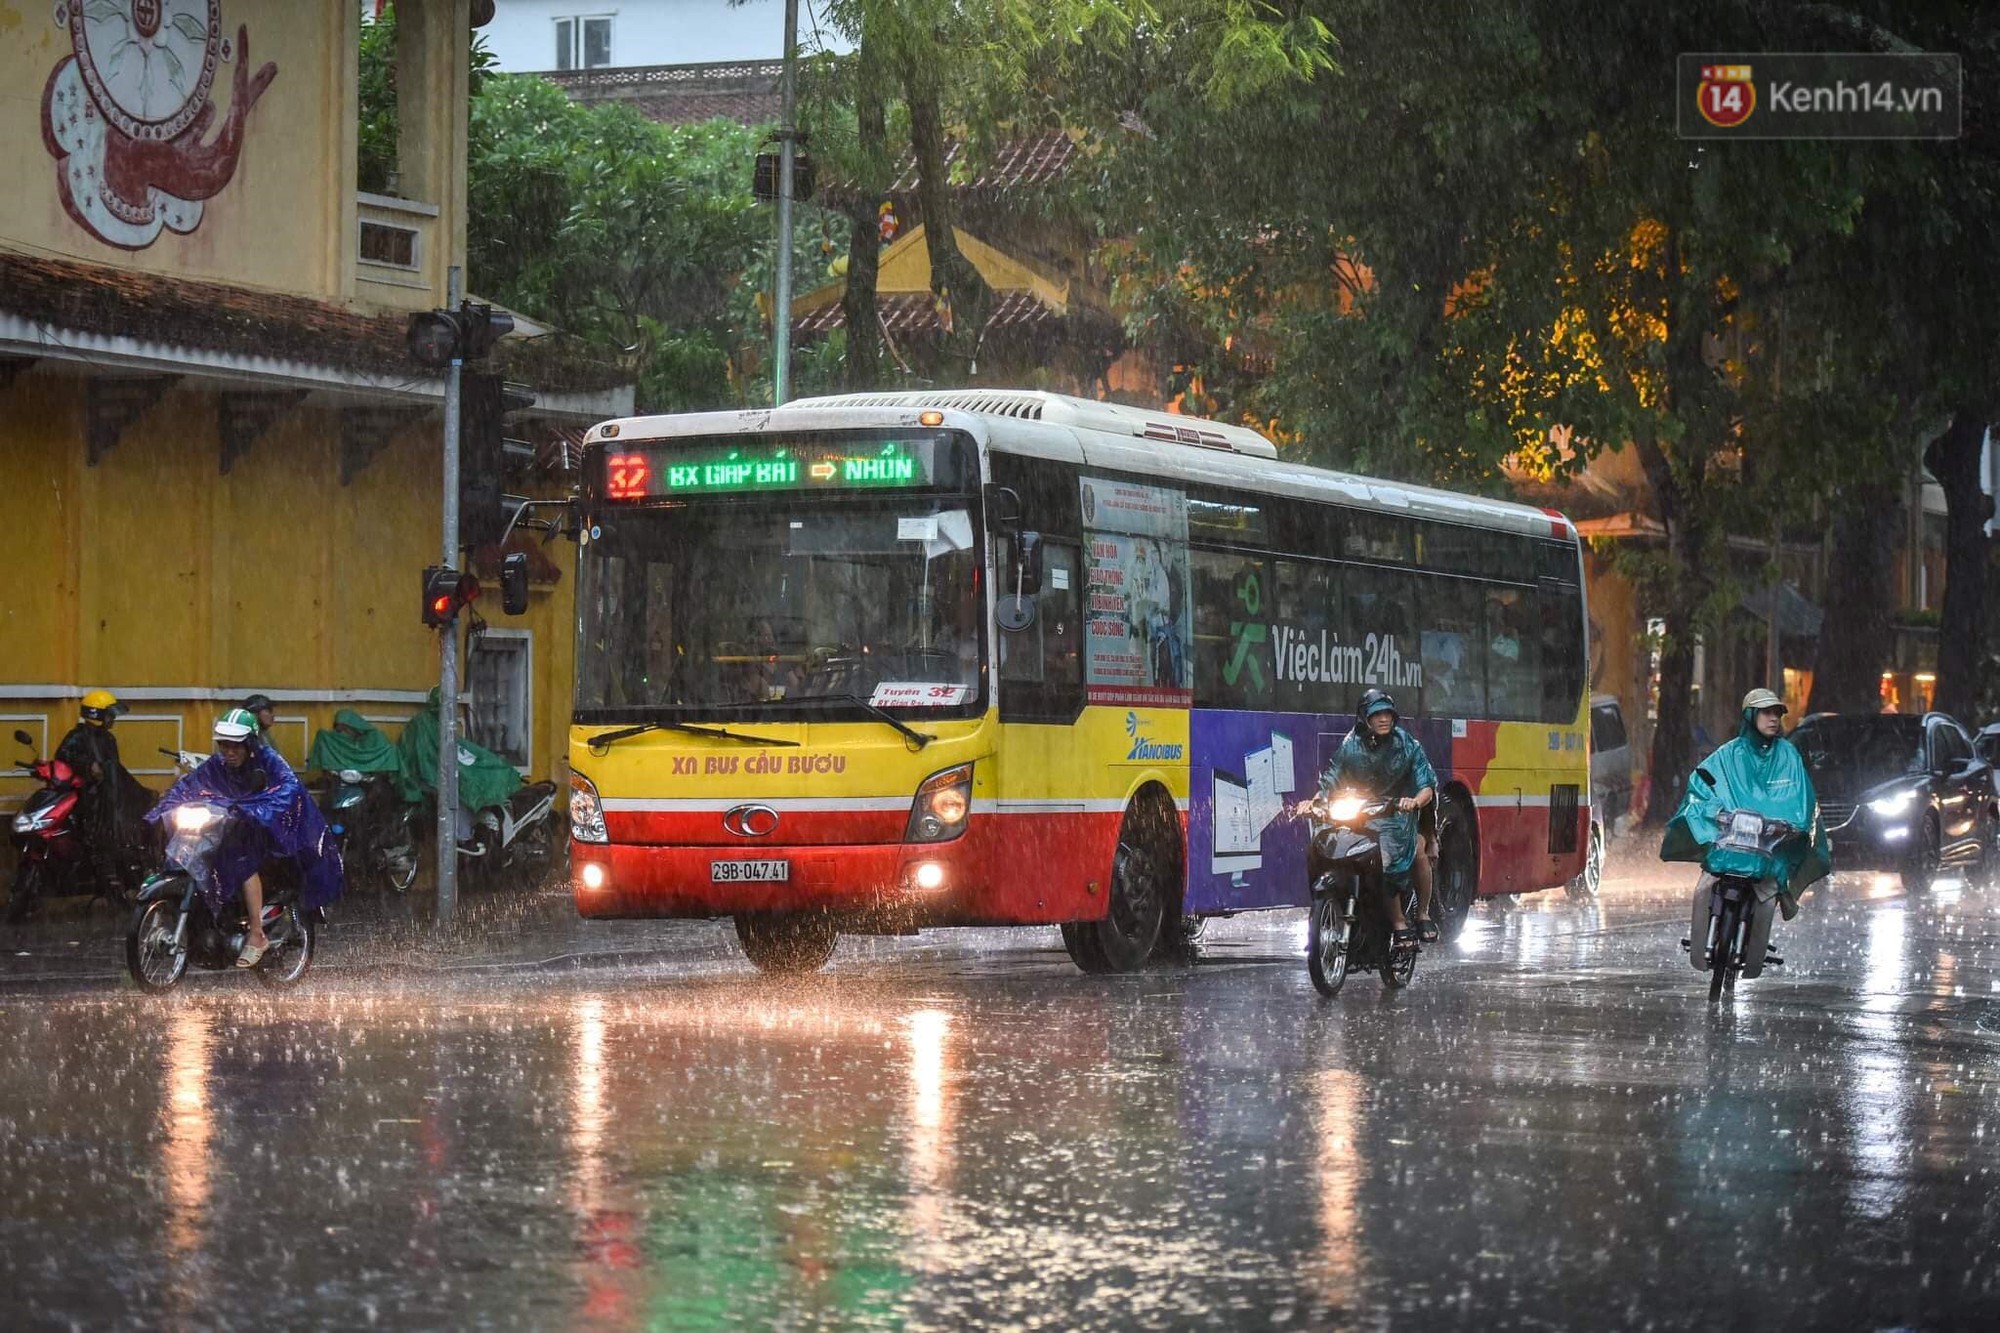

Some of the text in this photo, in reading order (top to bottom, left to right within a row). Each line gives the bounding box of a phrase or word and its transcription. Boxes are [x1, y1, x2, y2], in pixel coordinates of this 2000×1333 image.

[609, 454, 645, 497] 32
[846, 443, 912, 480] NHỔN
[672, 756, 698, 775] XN
[705, 756, 739, 774] BUS
